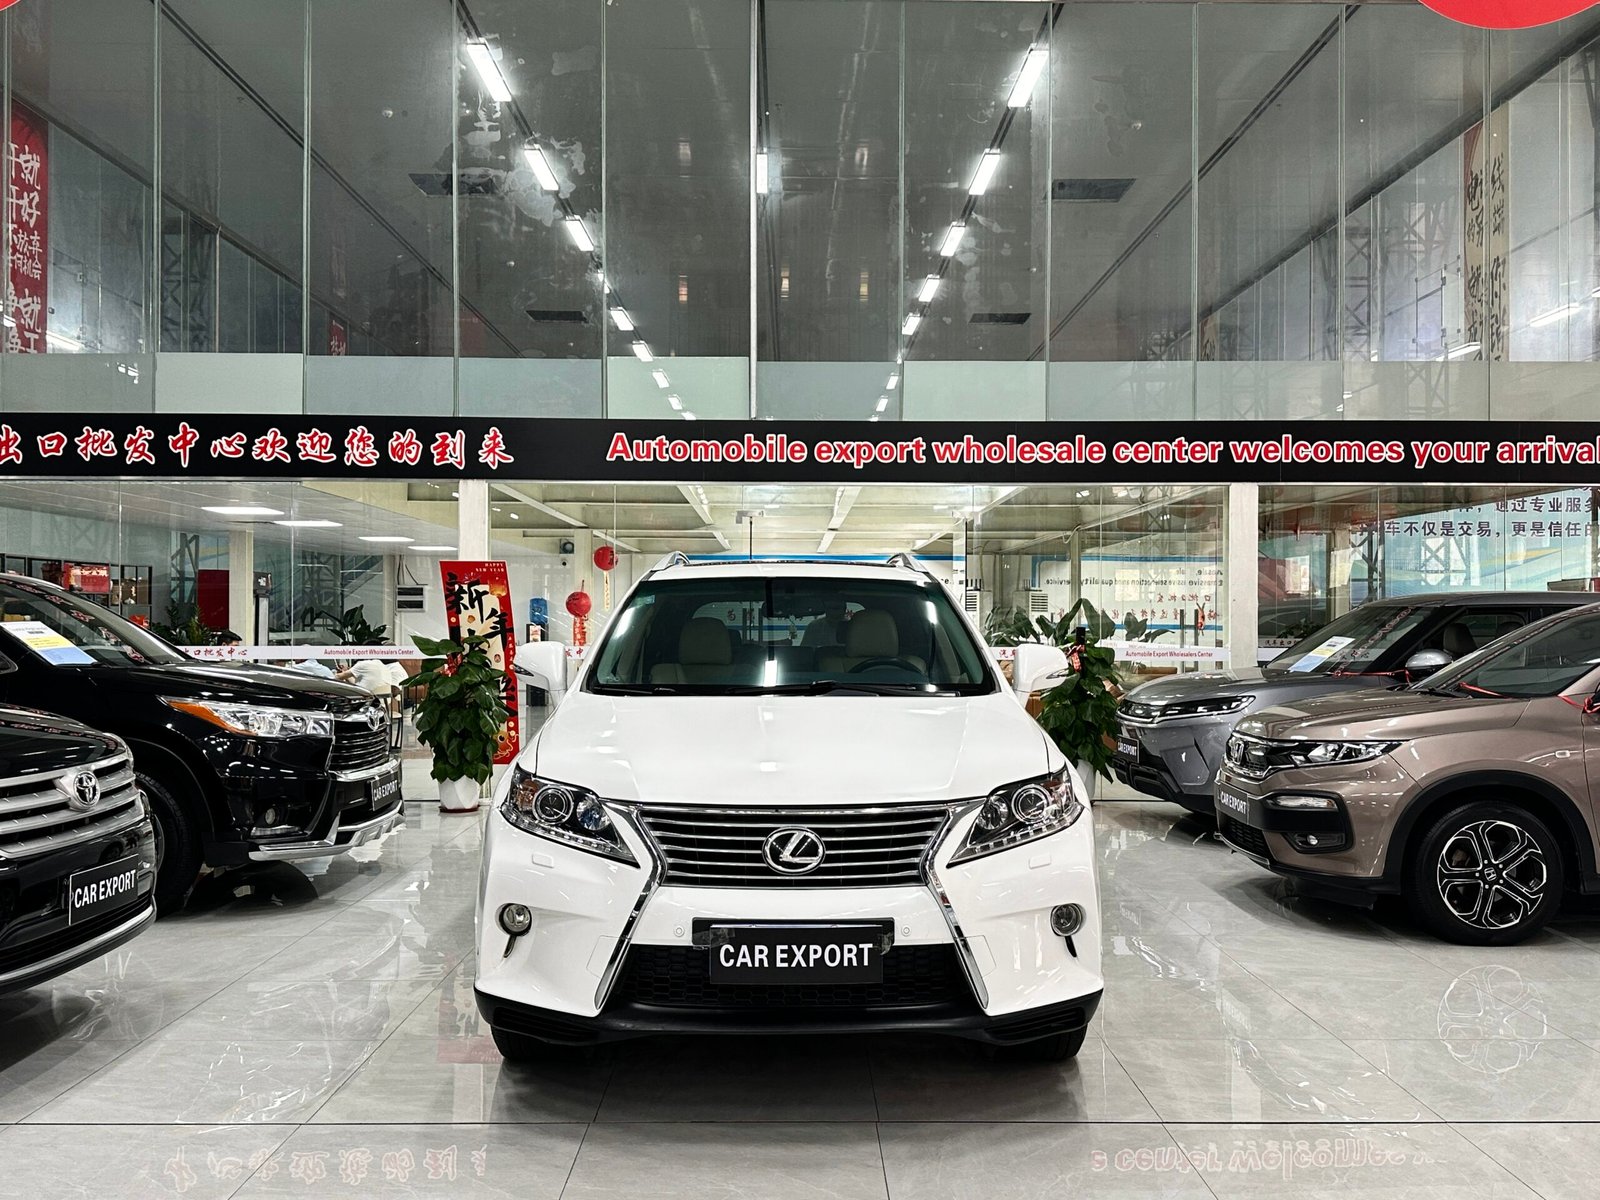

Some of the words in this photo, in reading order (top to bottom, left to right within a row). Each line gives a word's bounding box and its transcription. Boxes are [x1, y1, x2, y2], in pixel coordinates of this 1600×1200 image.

[606, 433, 808, 463] Automobile
[813, 437, 927, 469] export
[931, 435, 1107, 464] wholesale
[1112, 437, 1224, 464] center
[1229, 434, 1406, 464] welcomes
[1410, 441, 1491, 470] your
[352, 648, 368, 656] Export
[1153, 650, 1168, 658] Export
[74, 883, 97, 908] CAR
[99, 869, 136, 901] EXPORT
[719, 944, 769, 968] CAR
[775, 943, 873, 968] EXPORT
